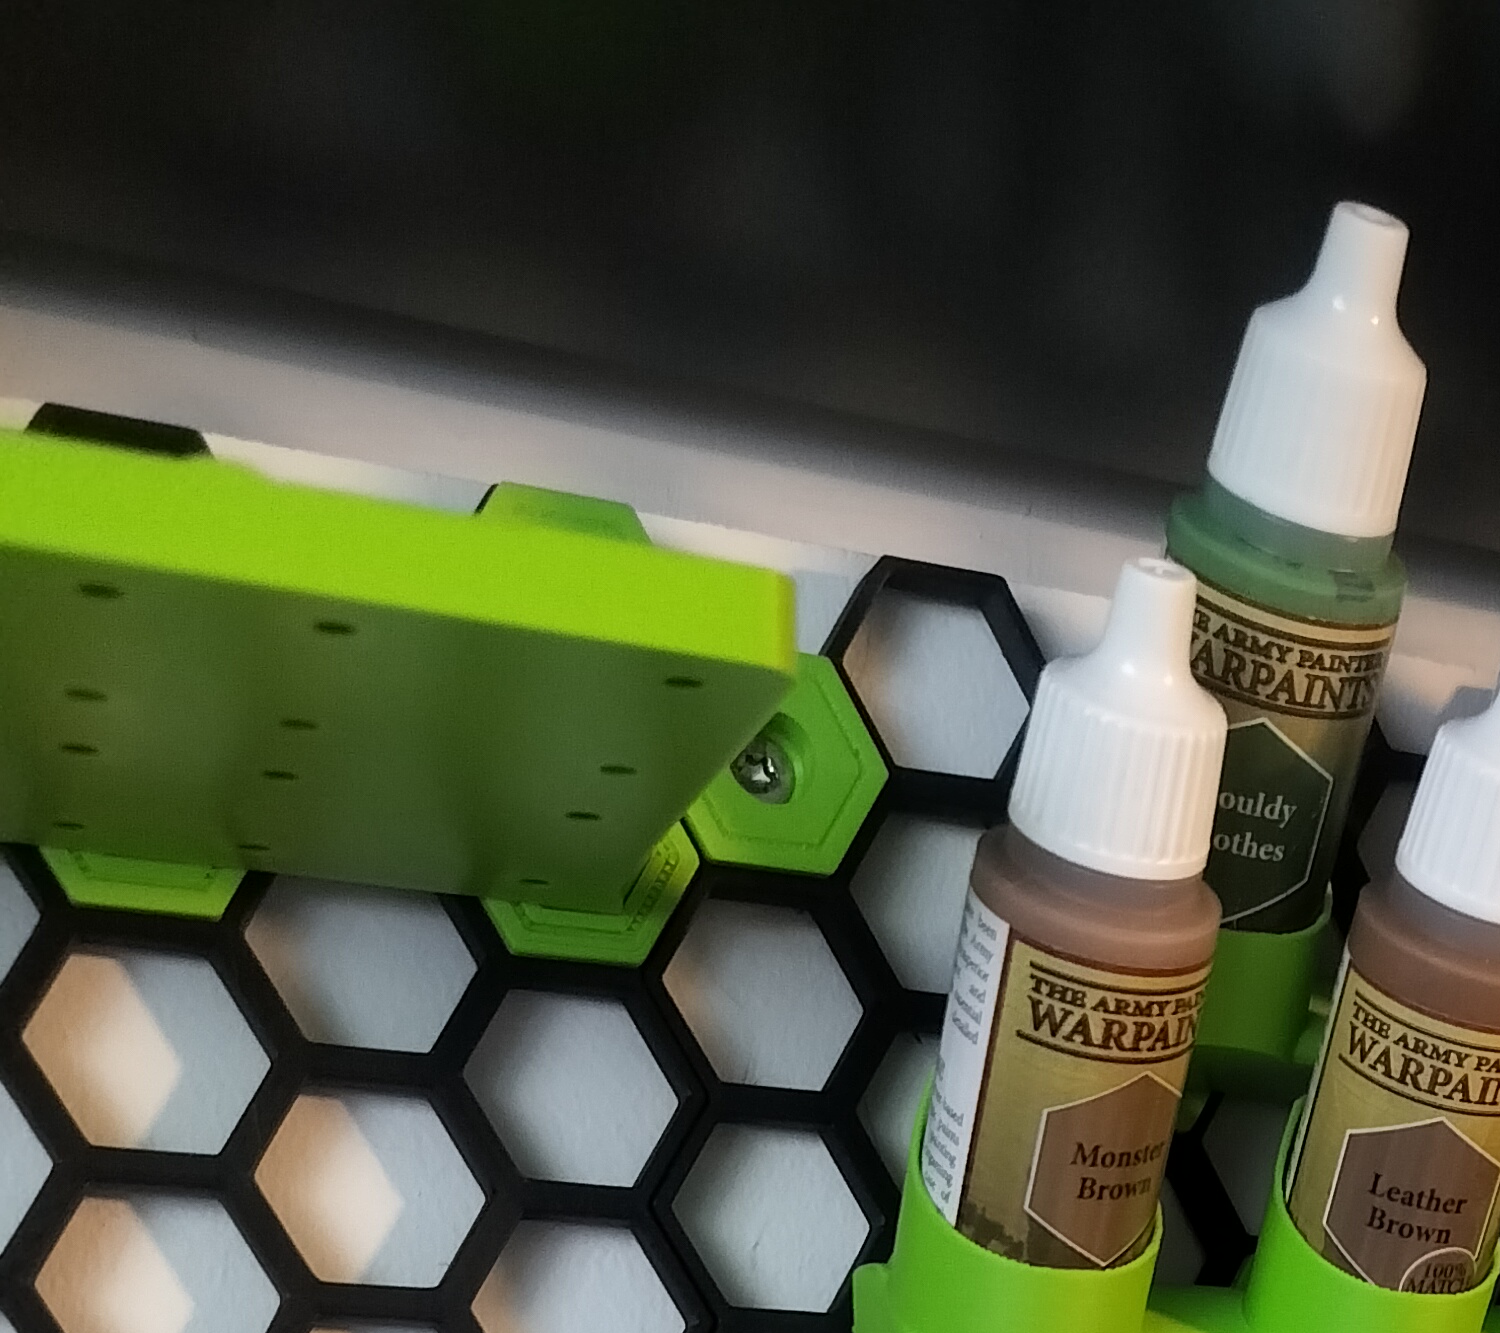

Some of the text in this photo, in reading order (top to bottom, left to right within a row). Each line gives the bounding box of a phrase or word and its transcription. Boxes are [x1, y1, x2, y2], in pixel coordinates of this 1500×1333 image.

[1212, 622, 1289, 664] ARMY
[1189, 632, 1379, 711] ARPAINTS
[1218, 790, 1298, 828] ouldy
[1213, 831, 1285, 863] othes
[1029, 972, 1087, 1008] THE
[1091, 996, 1171, 1018] ARMY
[1352, 1000, 1392, 1040] THE
[1393, 1031, 1473, 1069] ARMY
[1069, 1140, 1166, 1169] Monster
[1076, 1175, 1153, 1201] Brown
[1367, 1171, 1469, 1214] Leather
[1365, 1205, 1452, 1244] Brown
